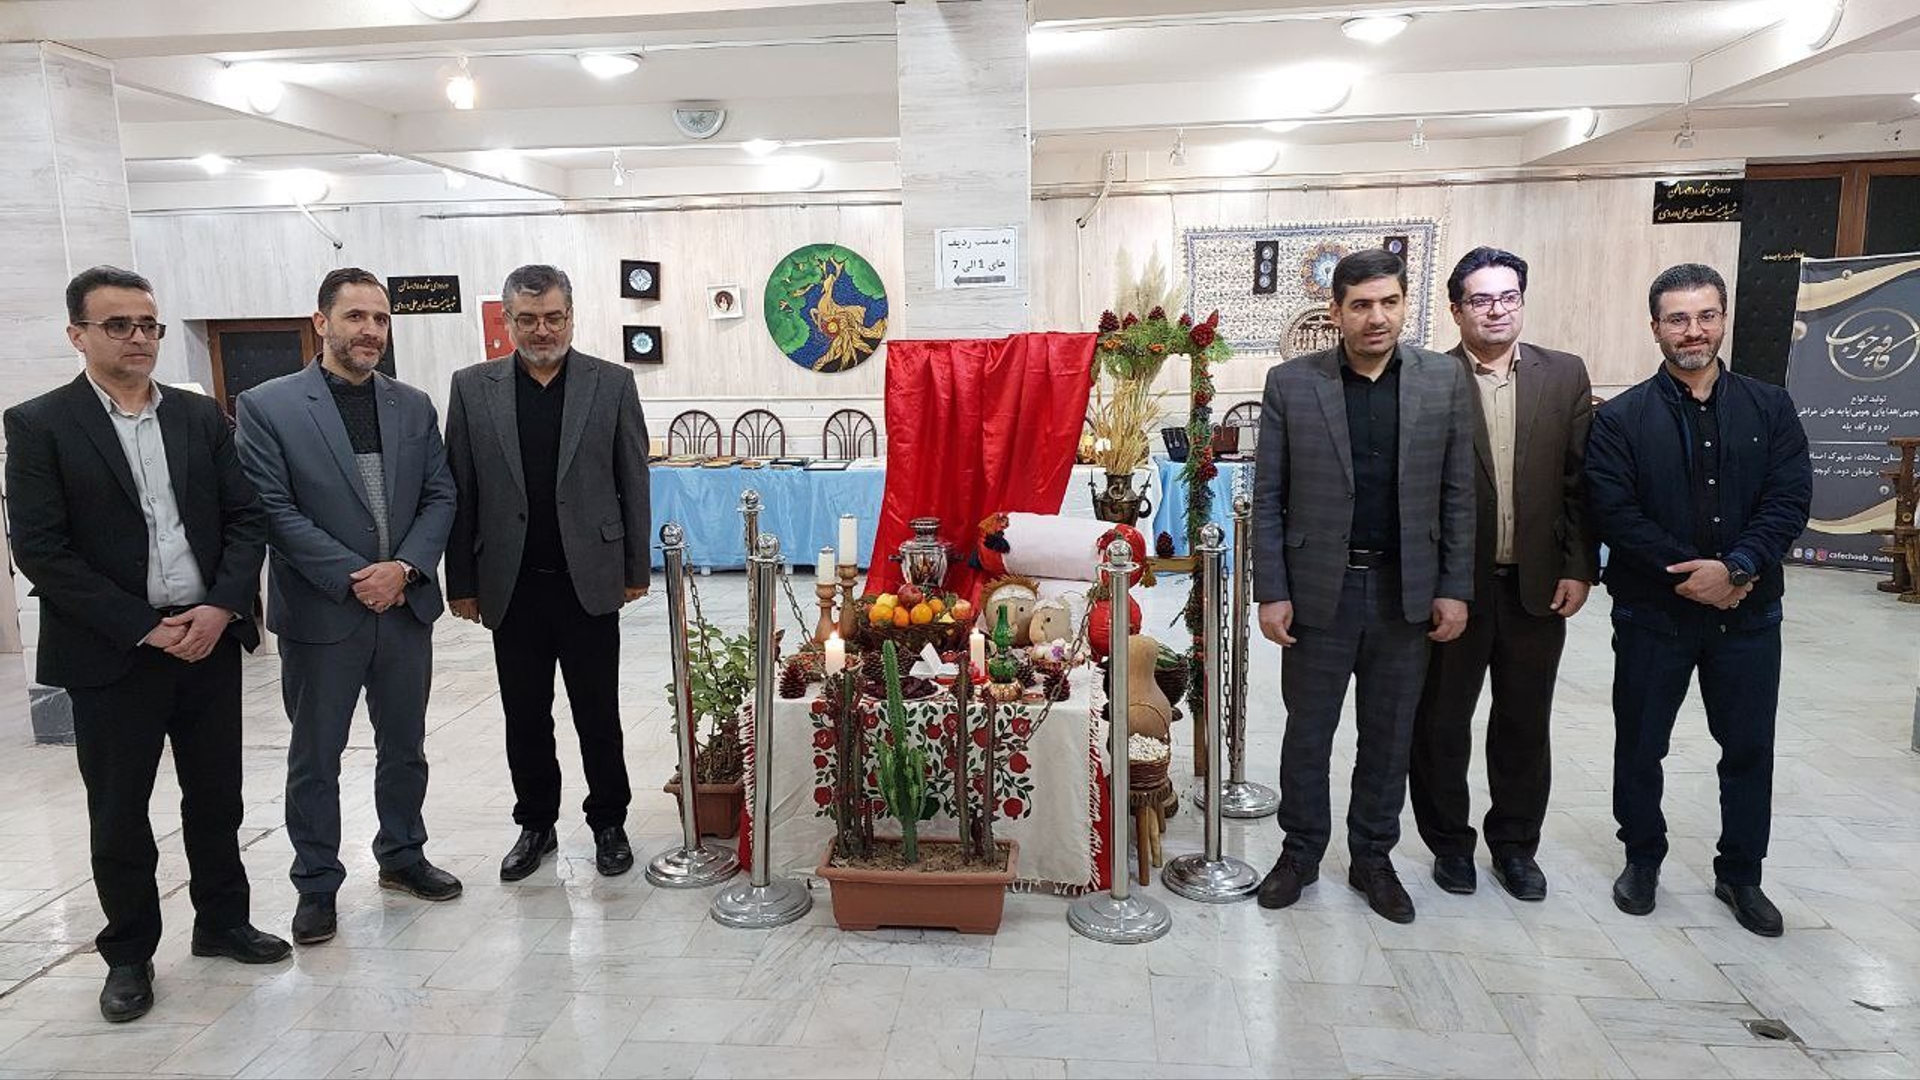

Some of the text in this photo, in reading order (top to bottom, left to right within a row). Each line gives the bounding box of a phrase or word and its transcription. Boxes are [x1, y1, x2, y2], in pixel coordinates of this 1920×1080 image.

[948, 239, 972, 249] ردیف
[1001, 237, 1011, 245] به
[952, 258, 1006, 273] های 1 الی 7
[1850, 395, 1887, 405] تولید انواع
[1820, 407, 1835, 417] های
[1842, 422, 1852, 432] پله
[1854, 422, 1867, 431] کف
[1873, 423, 1890, 433] نرده
[1809, 451, 1827, 460] اصنا
[1827, 451, 1853, 462] شهرک
[1851, 467, 1874, 478] خیابان
